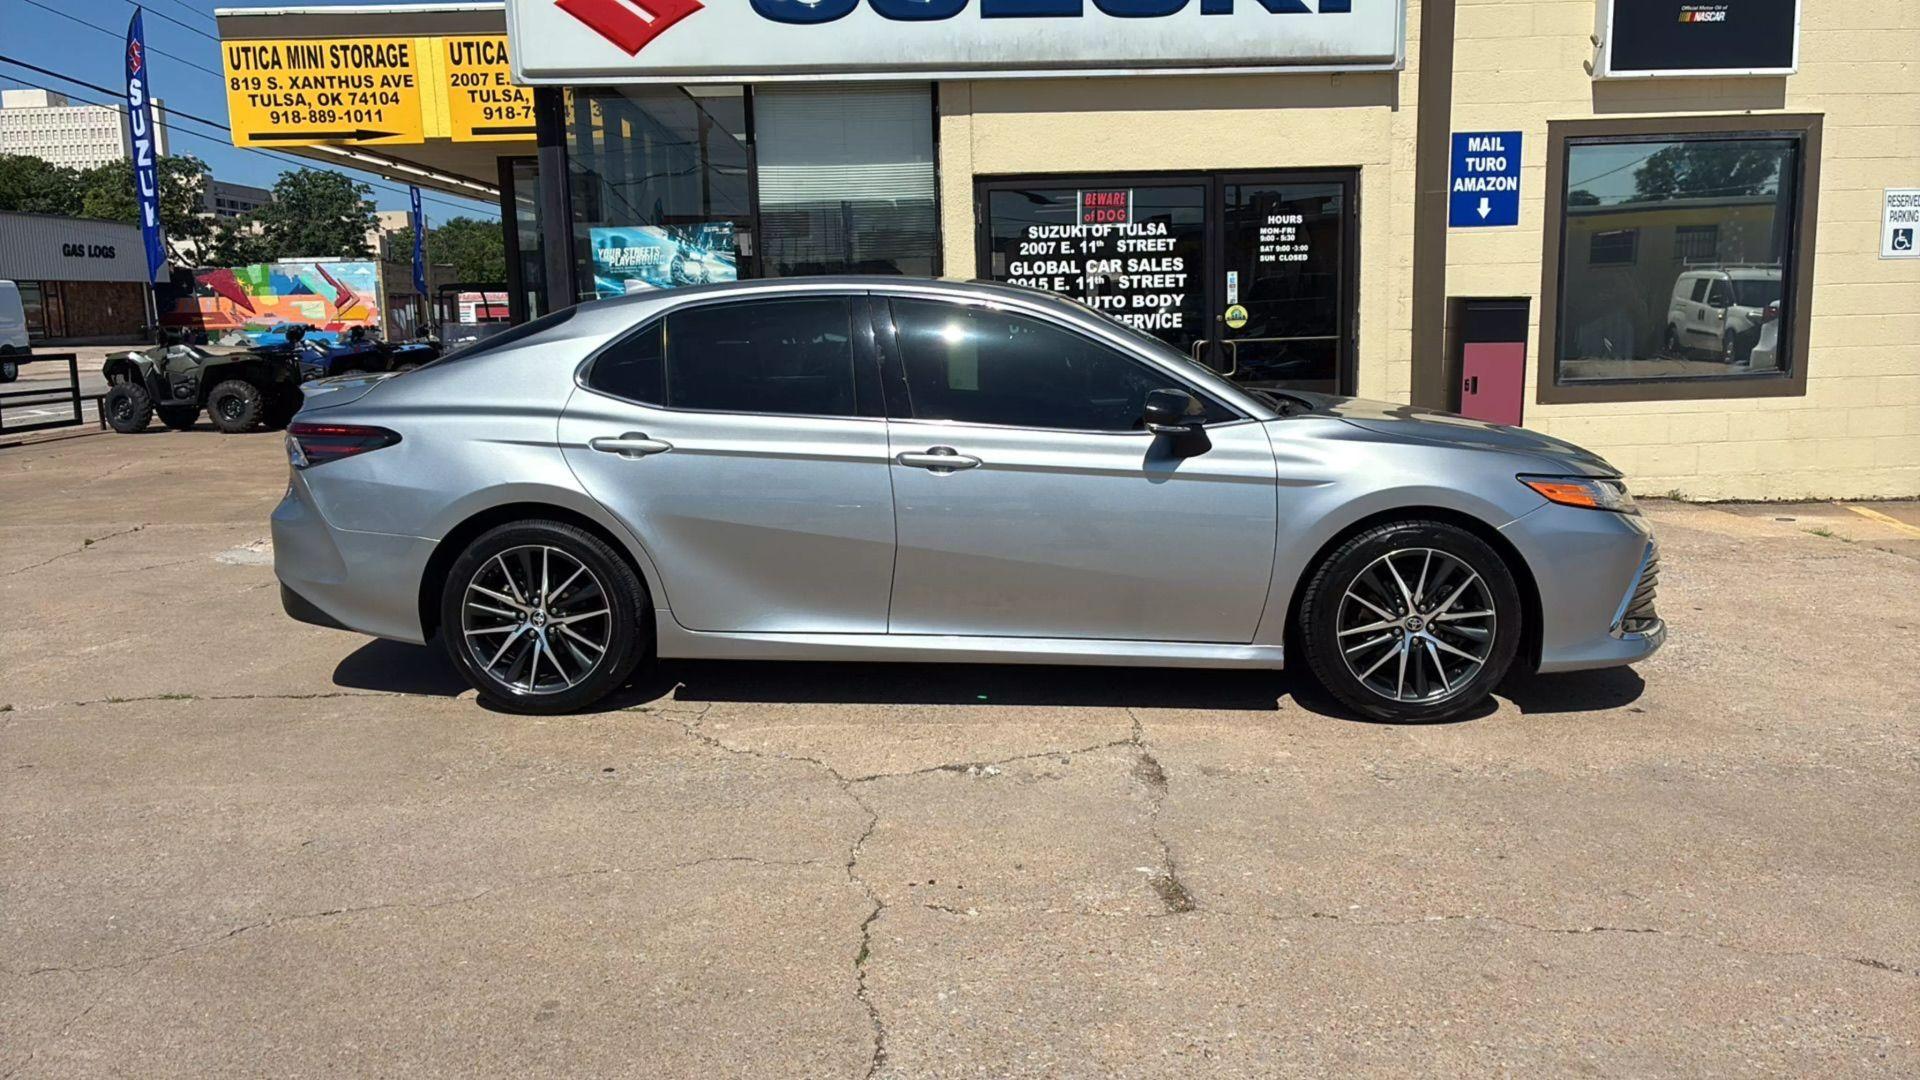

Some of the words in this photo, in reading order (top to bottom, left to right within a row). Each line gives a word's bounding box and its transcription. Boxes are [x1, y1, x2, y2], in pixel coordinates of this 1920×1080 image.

[1694, 12, 1725, 22] NASCAR
[230, 45, 282, 70] UTICA
[287, 45, 325, 69] MINI
[330, 43, 410, 69] STORAGE
[450, 41, 509, 65] UTICA
[230, 76, 262, 90] 819
[267, 76, 284, 90] S.
[289, 75, 374, 89] XANTHUS
[380, 74, 415, 88] AVE
[450, 73, 489, 87] 2007
[495, 72, 510, 86] E.
[248, 93, 312, 109] TULSA,
[317, 93, 344, 106] OK
[348, 91, 400, 105] 74104
[467, 89, 530, 104] TULSA,
[270, 109, 383, 124] 918-889-1011
[1468, 136, 1505, 152] MAIL
[1465, 157, 1507, 172] TURO
[1453, 176, 1517, 192] AMAZON
[1085, 192, 1126, 206] BEWARE
[1097, 210, 1126, 222] DOG
[1268, 215, 1303, 224] HOURS
[1889, 209, 1919, 222] PARKING
[1028, 225, 1087, 239] SUZUKI
[1092, 225, 1112, 238] OF
[1117, 222, 1167, 237] TULSA
[62, 243, 85, 257] GAS
[88, 244, 116, 259] LOGS
[598, 247, 621, 260] YOUR
[623, 246, 660, 257] STREETS
[1020, 242, 1056, 255] 2007
[1061, 241, 1075, 254] E.
[1080, 240, 1104, 253] 11th
[1117, 238, 1176, 252] STREET
[1279, 254, 1308, 262] CLOSED
[1009, 261, 1081, 276] GLOBAL
[1086, 260, 1122, 273] CAR
[1127, 257, 1184, 272] SALES
[1053, 277, 1070, 290] E.
[1076, 276, 1104, 290] 11th
[1118, 274, 1187, 289] STREET
[1132, 294, 1185, 308] BODY
[1114, 312, 1183, 330] ERVICE
